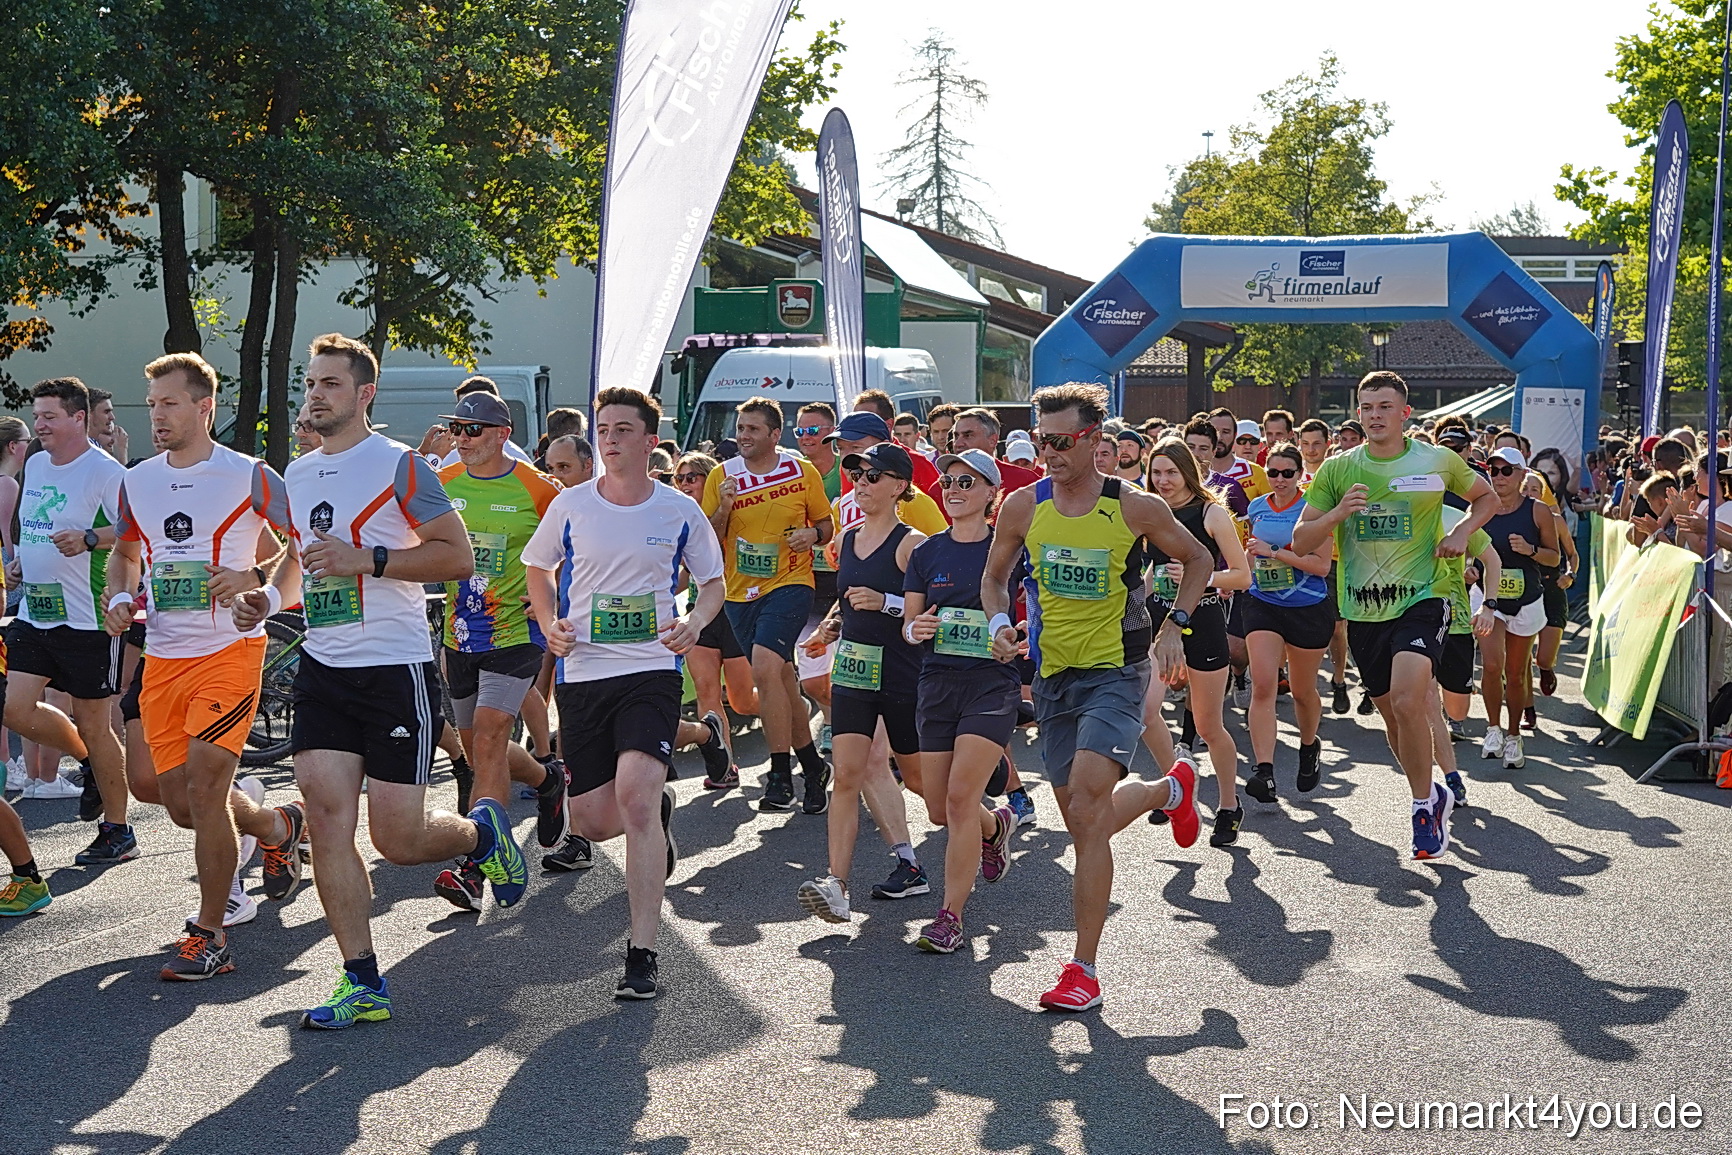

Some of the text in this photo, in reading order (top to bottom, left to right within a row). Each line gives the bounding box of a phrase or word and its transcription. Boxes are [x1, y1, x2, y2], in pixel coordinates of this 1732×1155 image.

[668, 0, 732, 115] Fisch
[1309, 258, 1342, 268] Fischer
[1284, 276, 1382, 295] firmenlauf
[1284, 295, 1325, 303] neumarkt
[1093, 308, 1146, 320] Fischer
[714, 377, 759, 388] abavent
[731, 482, 806, 511] MAX BÖGL
[22, 517, 54, 531] Laufend
[1370, 515, 1398, 529] 679
[473, 547, 491, 562] 22
[741, 553, 772, 567] 1615
[1051, 563, 1097, 584] 1596
[1264, 569, 1279, 580] 16
[162, 578, 193, 595] 373
[1050, 581, 1073, 589] Werner
[1098, 570, 1106, 593] 2022
[1499, 579, 1515, 589] 95
[200, 580, 208, 604] 2022
[31, 596, 53, 609] 348
[312, 590, 343, 610] 374
[349, 590, 359, 616] 2022
[327, 608, 348, 616] Daniel
[607, 612, 643, 629] 313
[600, 627, 650, 636] Hupfer Dominik
[948, 624, 982, 642] 494
[840, 657, 866, 675] 480
[871, 663, 879, 684] 2022
